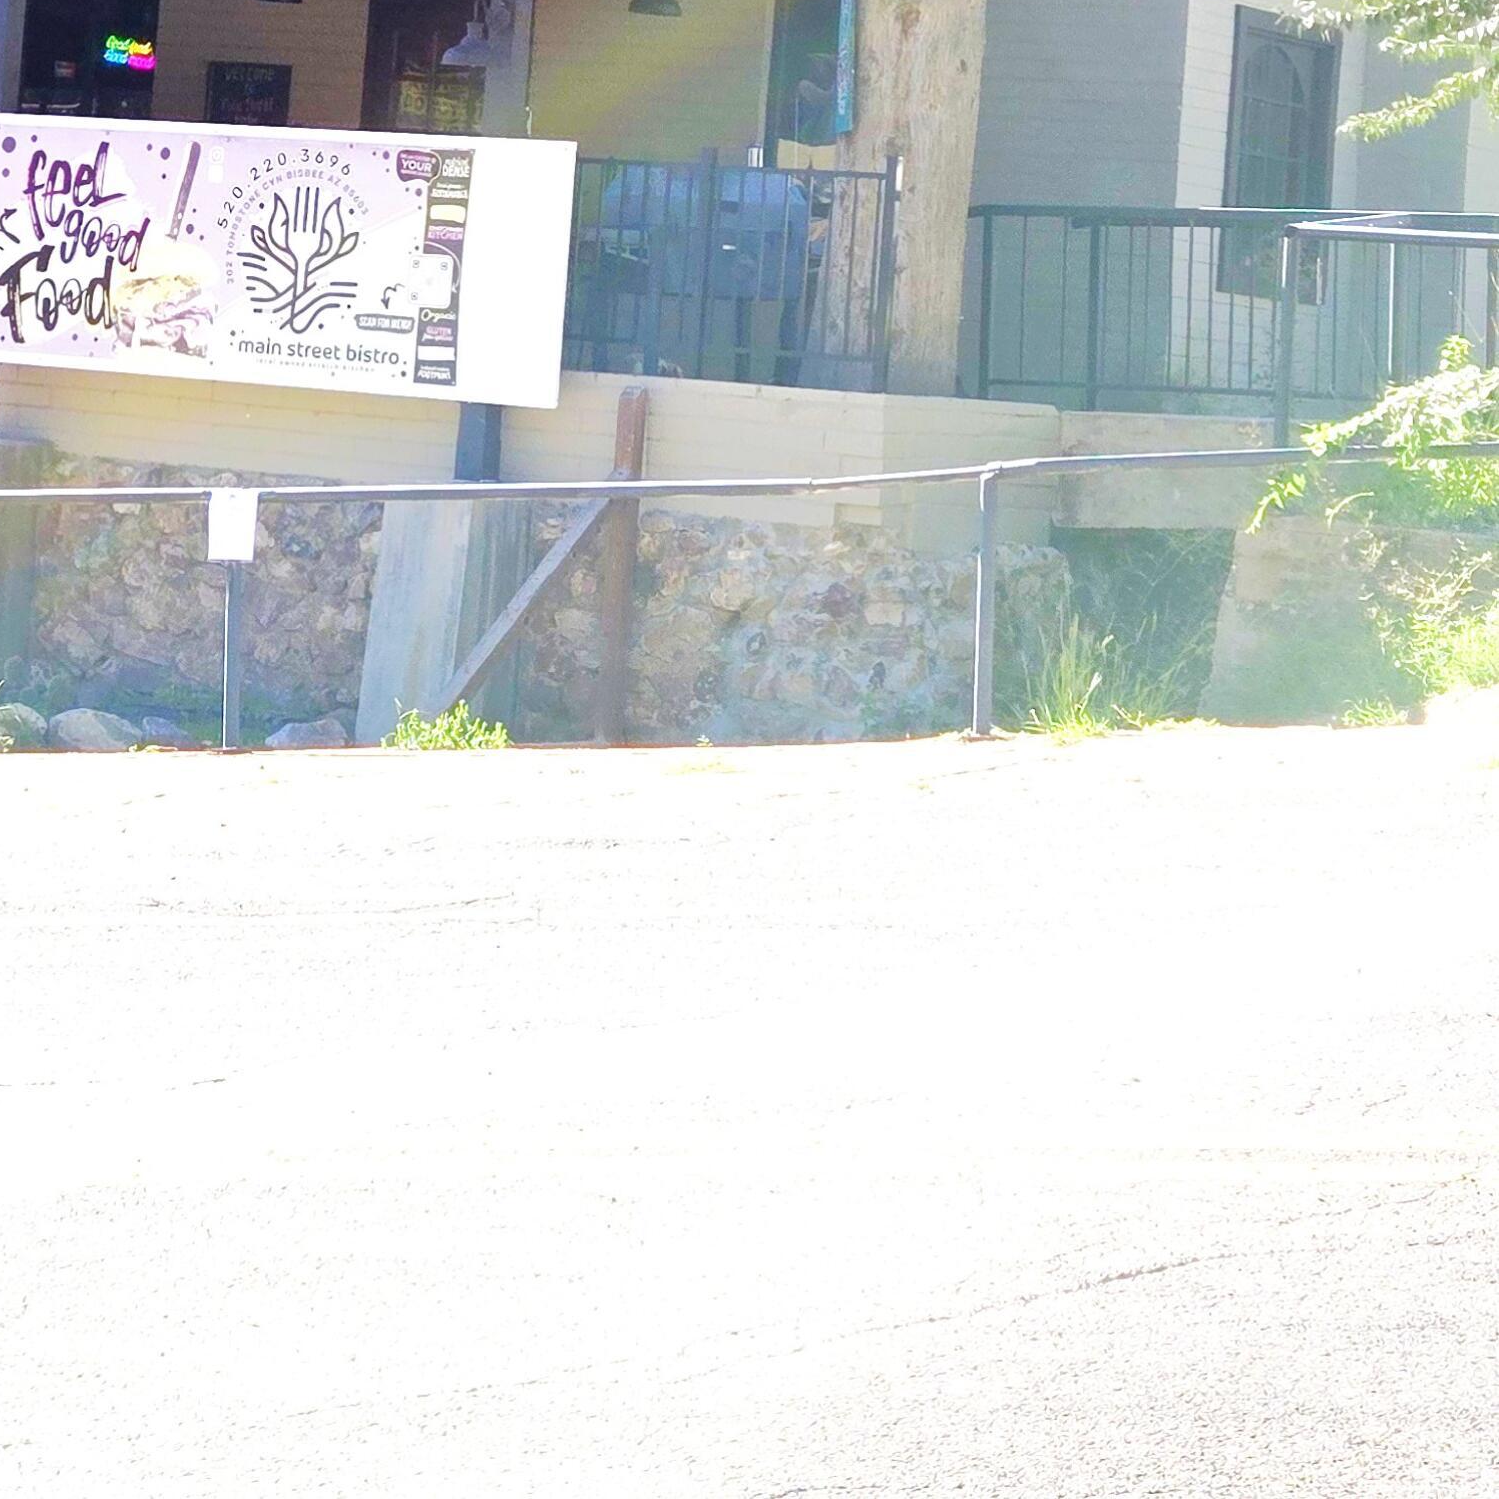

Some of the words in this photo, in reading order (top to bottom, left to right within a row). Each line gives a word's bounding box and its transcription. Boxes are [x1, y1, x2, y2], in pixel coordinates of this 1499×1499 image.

[401, 159, 433, 173] YOUR
[442, 164, 471, 178] DENSE
[22, 141, 127, 241] feel
[217, 148, 351, 229] 520.220.3696
[226, 189, 261, 256] TOMBSTONE
[262, 174, 283, 190] CYN
[286, 168, 325, 180] BISBEE
[327, 174, 342, 187] AZ
[60, 209, 150, 272] good
[358, 316, 376, 327] SCAN
[377, 318, 390, 328] FOR
[421, 308, 456, 323] Organic
[239, 337, 282, 355] main
[287, 342, 340, 360] street
[346, 344, 399, 364] bistro
